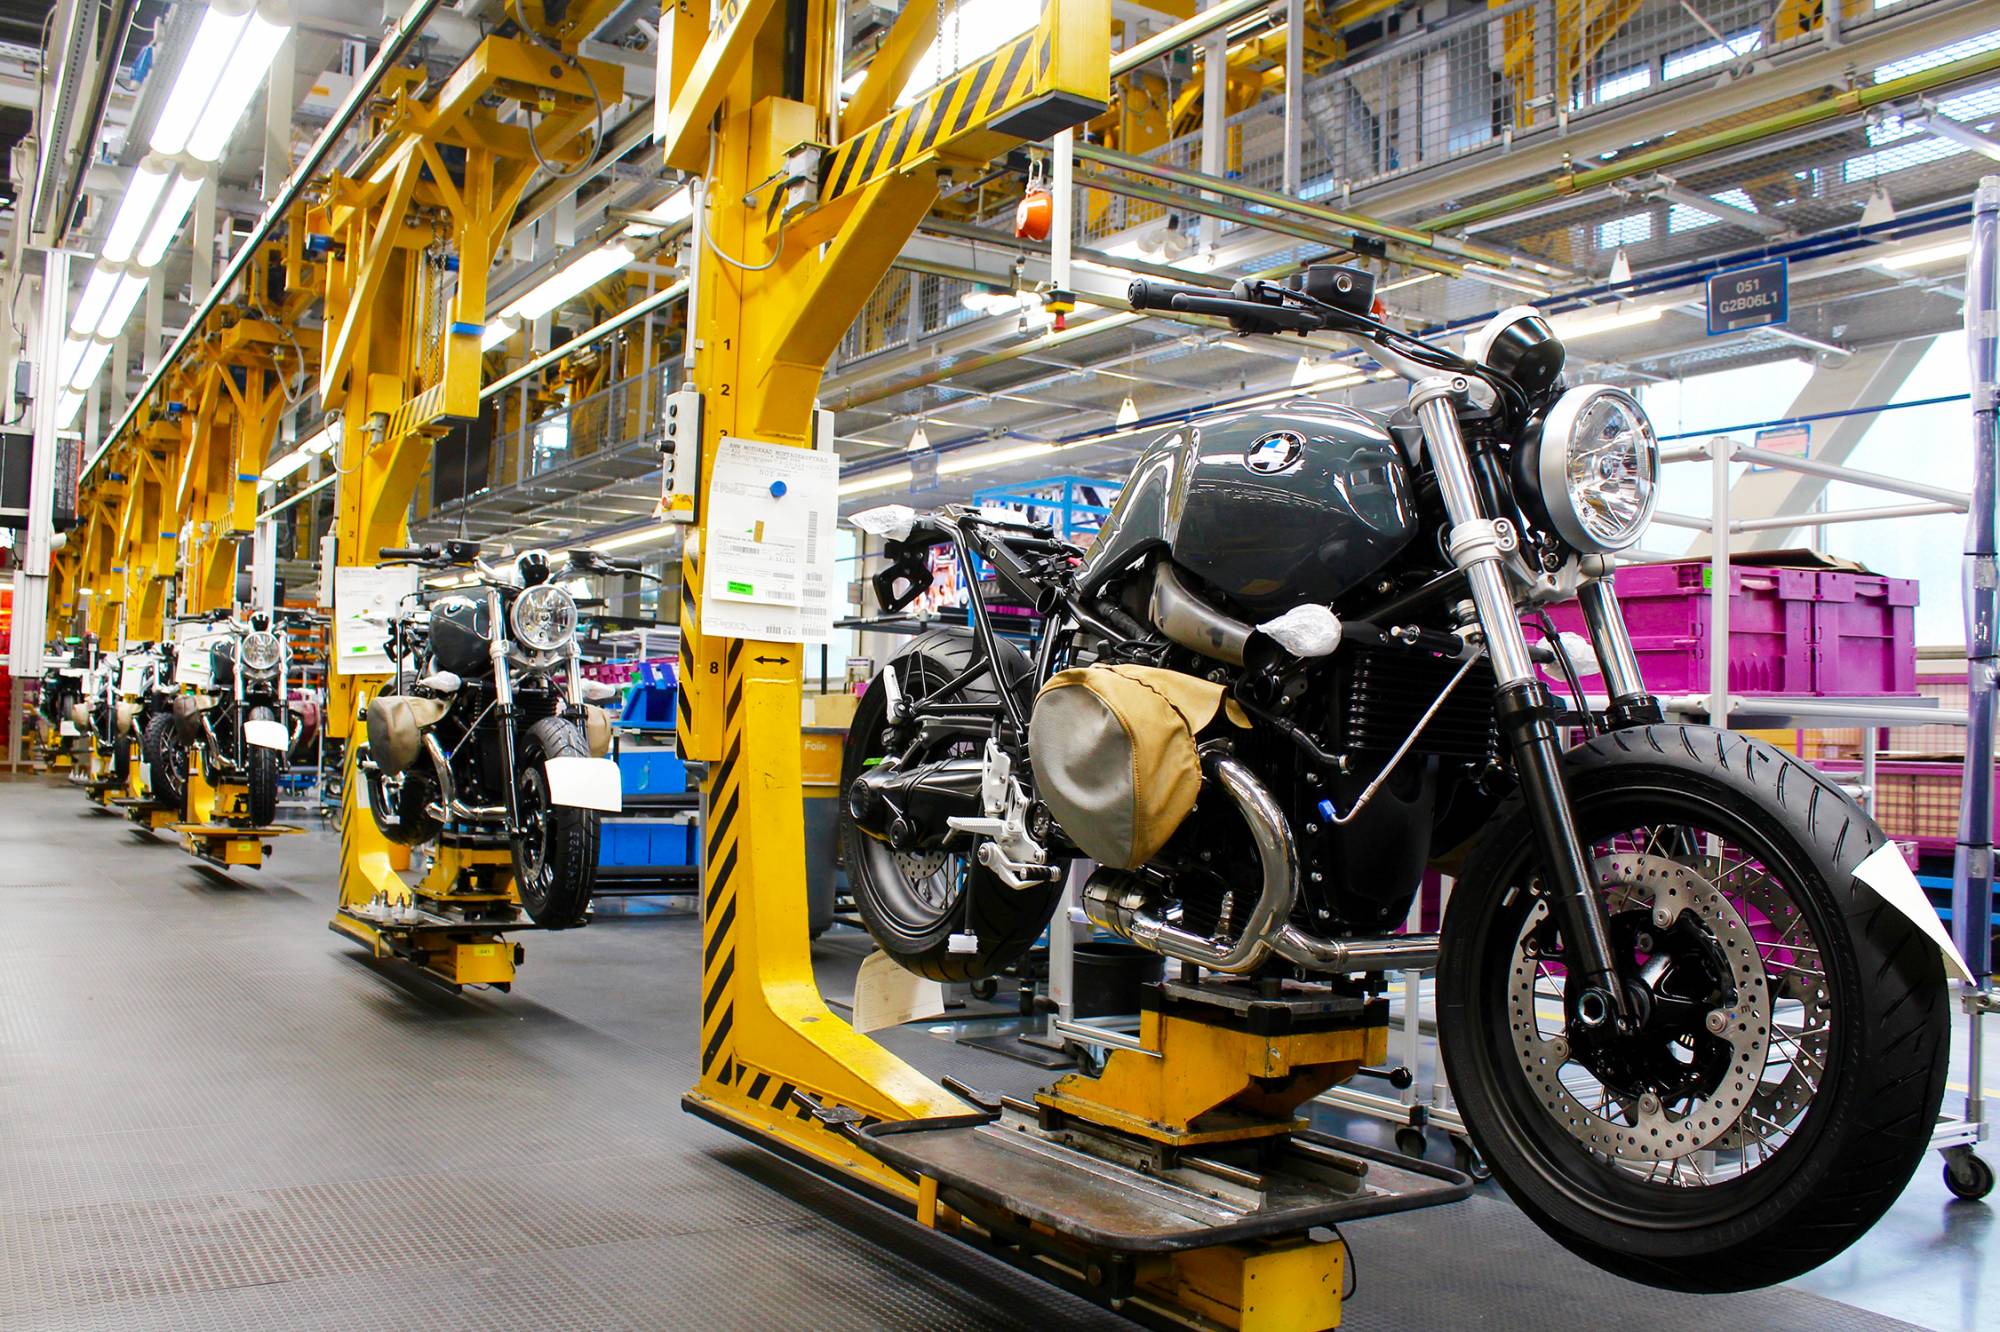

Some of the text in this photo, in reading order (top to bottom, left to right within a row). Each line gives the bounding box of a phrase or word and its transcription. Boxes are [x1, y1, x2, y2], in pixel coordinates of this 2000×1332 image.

[1736, 279, 1760, 294] 051
[1720, 291, 1778, 313] G2B06L1
[723, 338, 731, 351] 1
[720, 383, 730, 397] 2
[709, 661, 719, 674] 8
